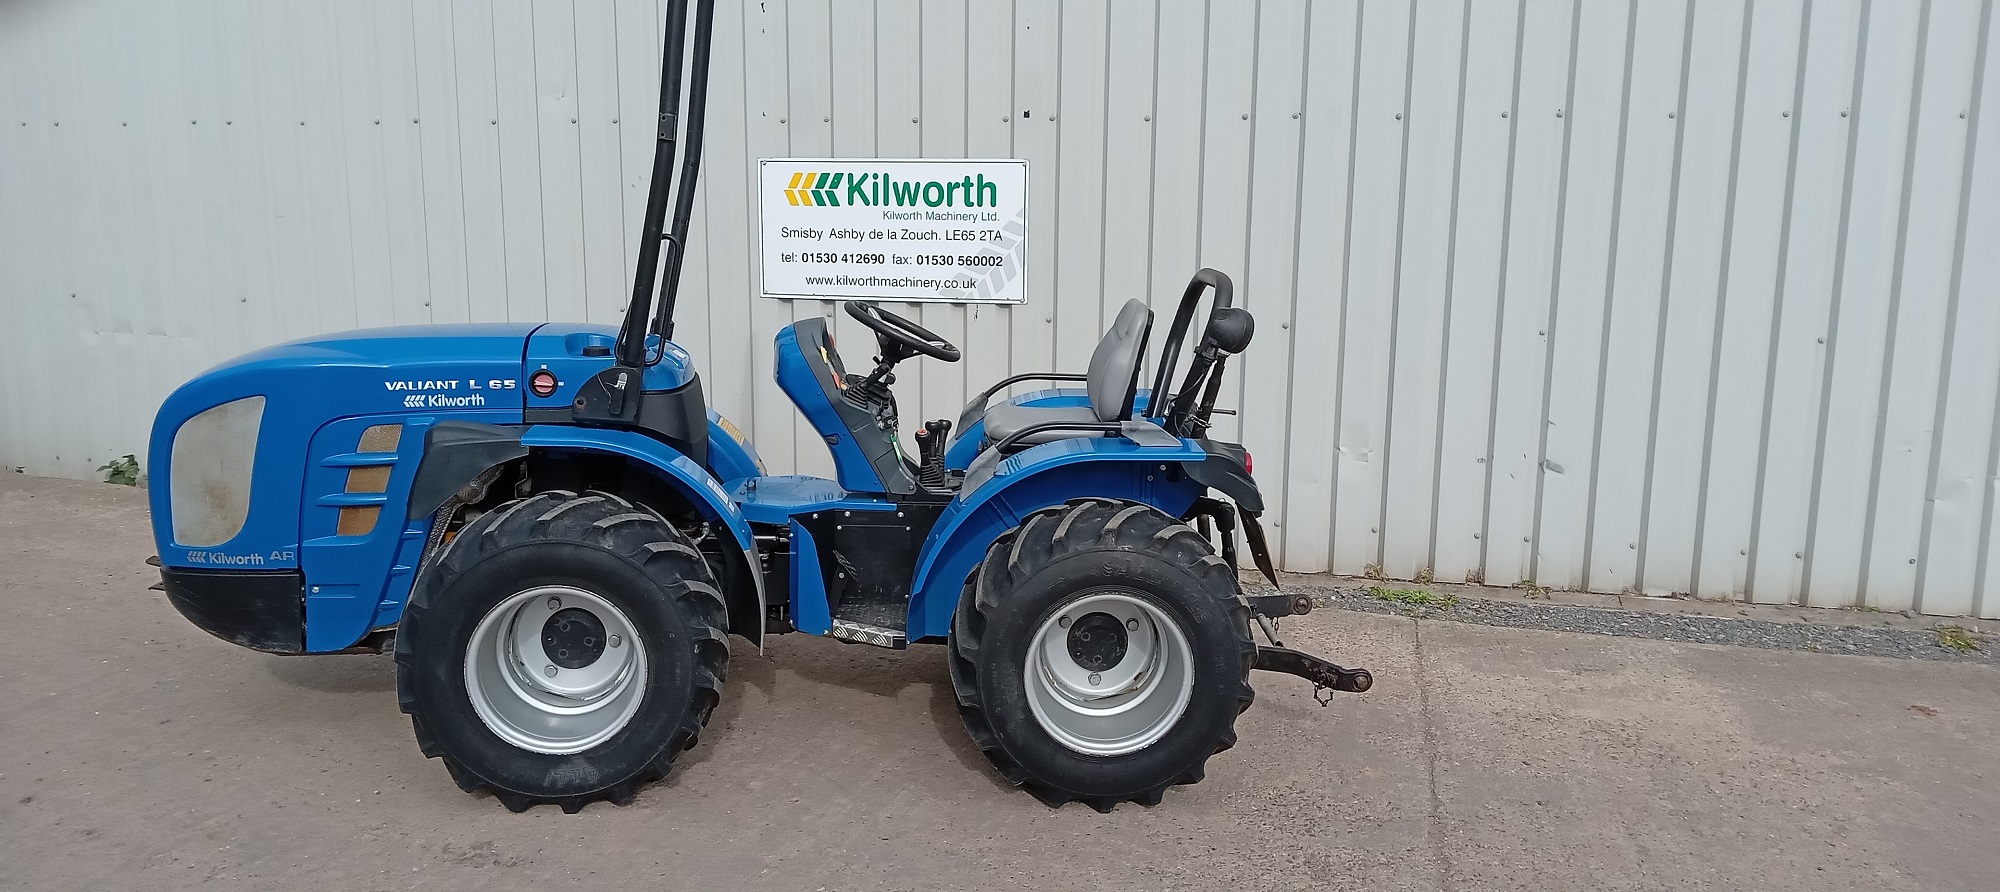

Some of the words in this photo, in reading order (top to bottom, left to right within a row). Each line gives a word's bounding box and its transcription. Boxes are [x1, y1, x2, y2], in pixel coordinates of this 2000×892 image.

[848, 173, 996, 207] Kilworth
[882, 210, 923, 221] Kilworth
[925, 210, 979, 224] Machinery
[981, 211, 1000, 222] Ltd.
[781, 226, 824, 242] Smisby
[828, 227, 866, 243] Ashby
[868, 228, 884, 240] de
[887, 228, 898, 240] la
[900, 228, 942, 241] Zouch.
[945, 229, 976, 242] LE65
[979, 229, 1003, 242] 2TA
[781, 251, 798, 263] tel:
[801, 252, 838, 264] 01530
[840, 253, 885, 265] 412690
[891, 253, 913, 265] fax:
[916, 254, 954, 266] 01530
[957, 255, 1004, 267] 560002
[805, 274, 977, 292] www.kilworthmachinery.co.uk
[384, 380, 460, 391] VALIANT
[469, 379, 483, 390] L
[488, 379, 516, 390] 65
[428, 392, 485, 408] Kilworth
[208, 552, 264, 566] Kilworth
[269, 550, 295, 562] AR
